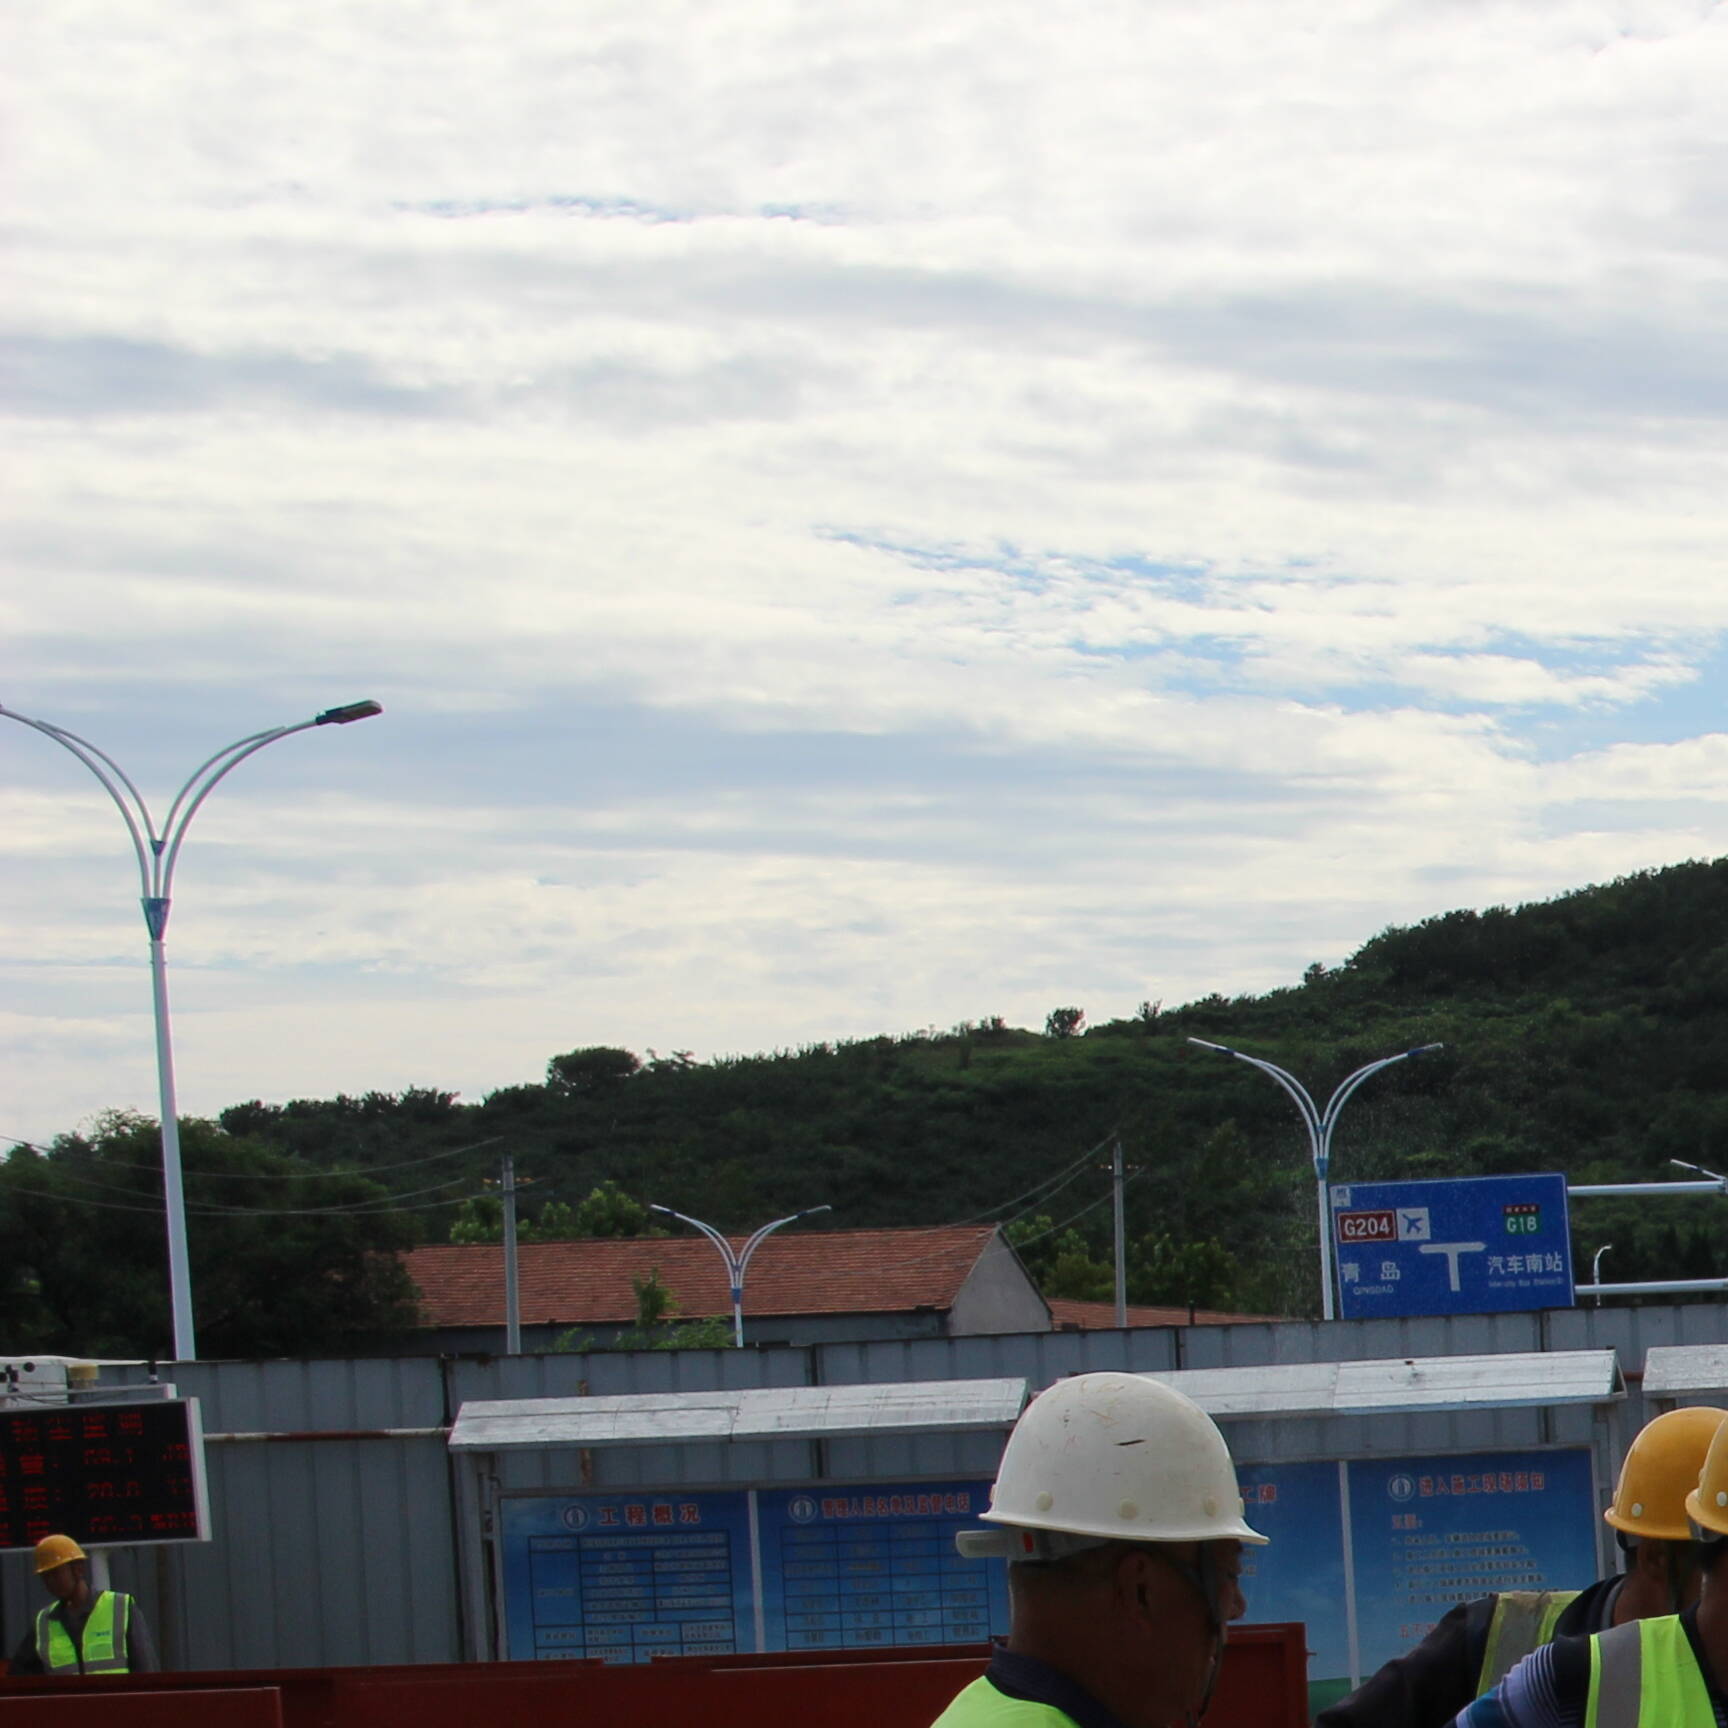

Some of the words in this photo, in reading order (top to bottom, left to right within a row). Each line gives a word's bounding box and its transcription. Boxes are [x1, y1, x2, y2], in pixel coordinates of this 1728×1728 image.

[1344, 1217, 1390, 1237] G204
[1506, 1216, 1537, 1234] G18
[1342, 1261, 1401, 1283] 青岛
[1487, 1252, 1563, 1275] 汽车南站
[597, 1503, 701, 1526] 工程概况
